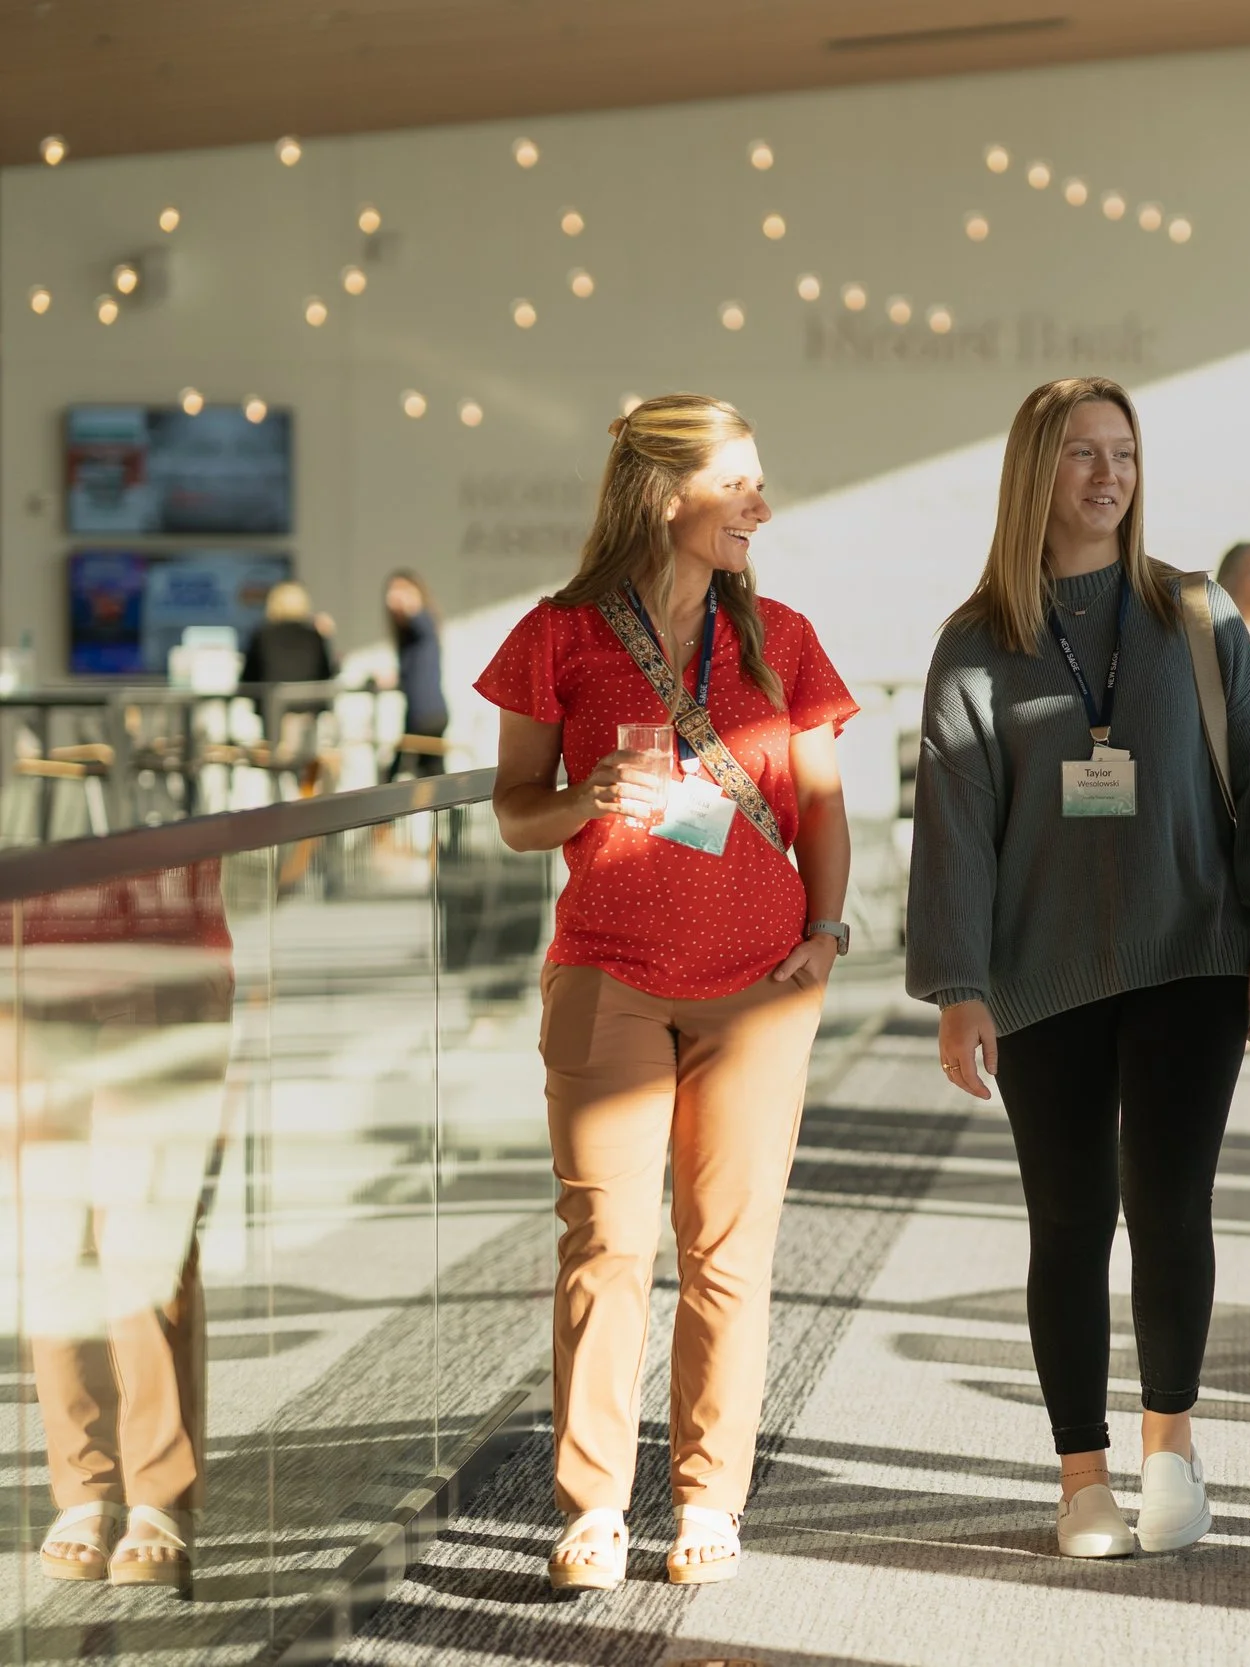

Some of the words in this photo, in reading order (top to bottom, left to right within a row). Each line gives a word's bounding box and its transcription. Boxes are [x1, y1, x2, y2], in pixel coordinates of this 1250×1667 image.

[1060, 638, 1071, 653] NEW
[1067, 653, 1080, 672] SAGE
[1107, 672, 1115, 688] NEW
[698, 684, 708, 704] SAGE
[1084, 768, 1112, 778] Taylor
